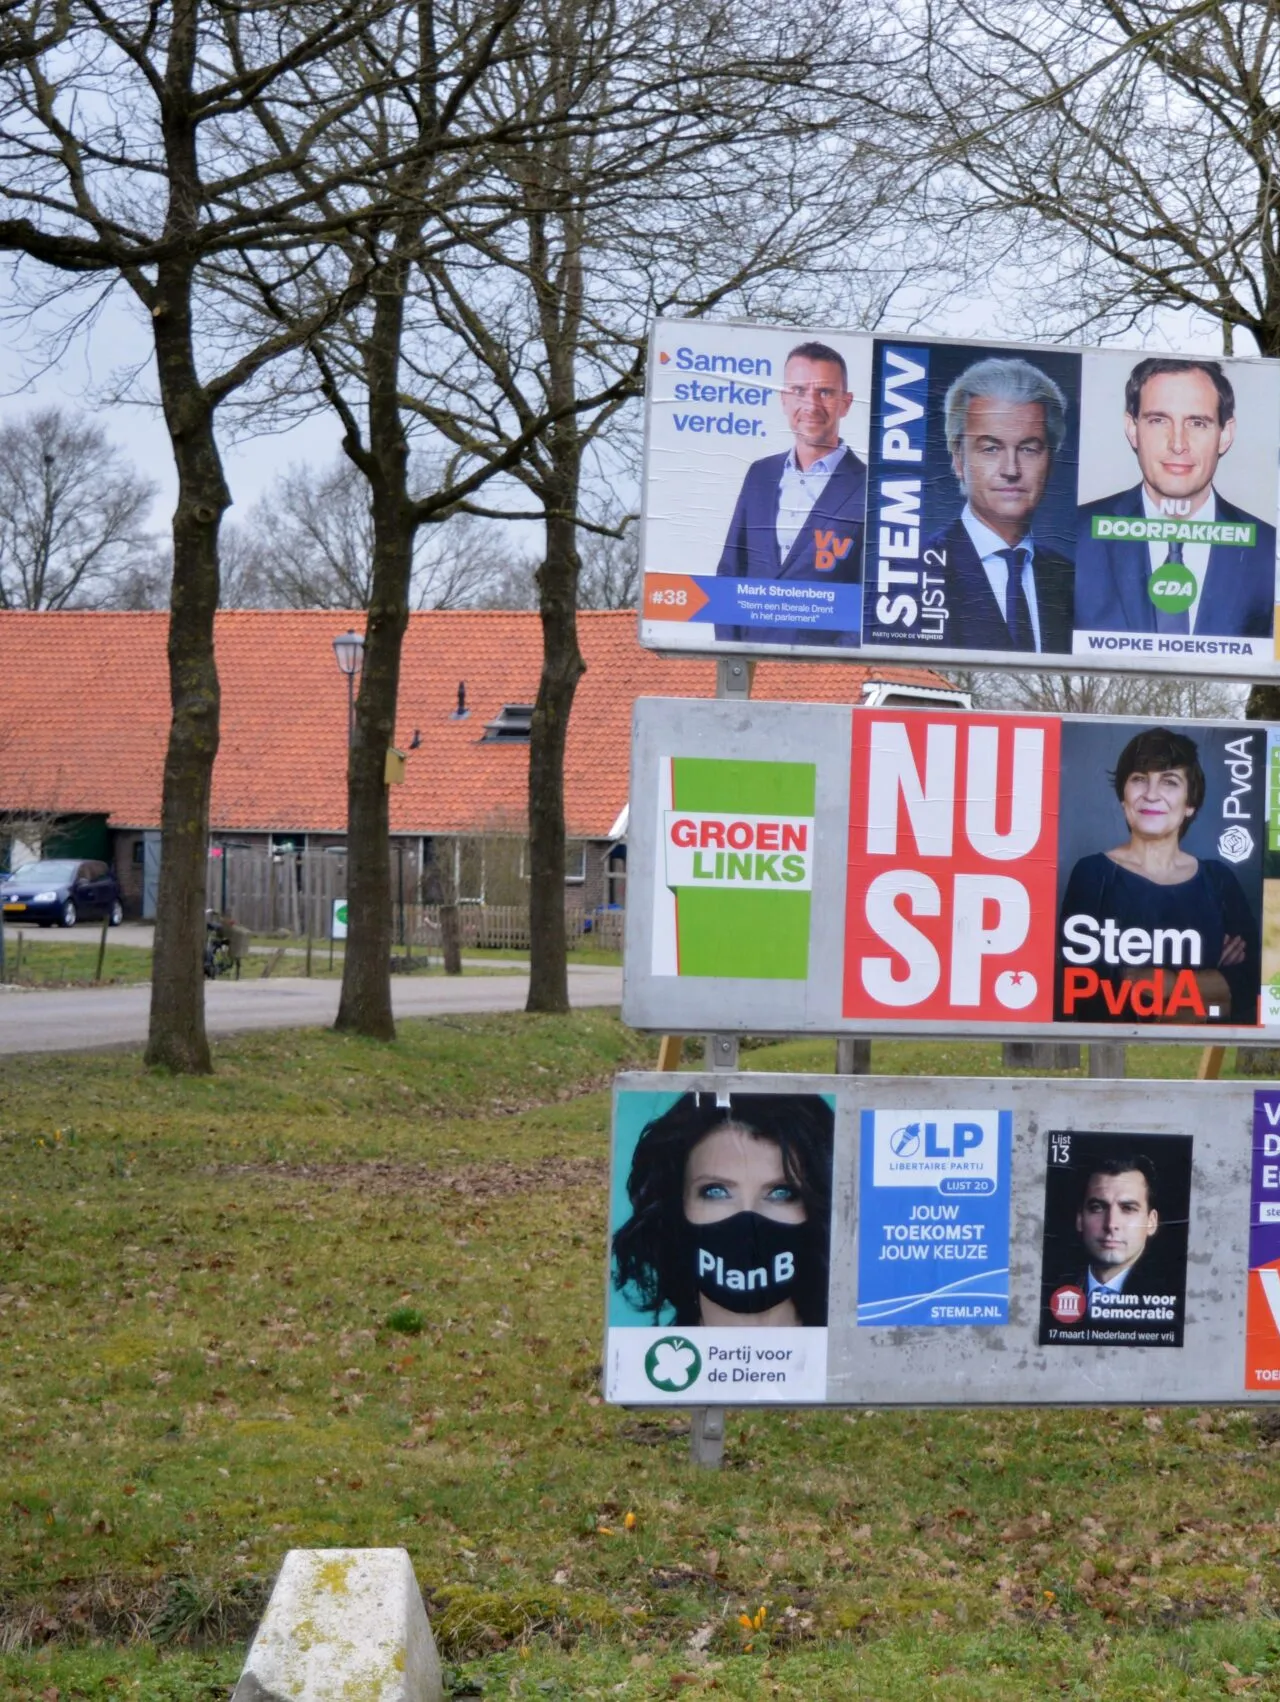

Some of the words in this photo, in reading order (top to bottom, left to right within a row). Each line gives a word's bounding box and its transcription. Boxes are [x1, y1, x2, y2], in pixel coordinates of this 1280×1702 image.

[675, 348, 772, 376] Samen
[674, 379, 773, 406] sterker
[882, 349, 928, 462] PVV
[672, 411, 767, 438] verder.
[1159, 499, 1191, 516] NU
[1096, 519, 1251, 543] DOORPAKKEN
[876, 480, 923, 627] STEM
[923, 549, 947, 567] 2
[737, 584, 767, 596] Mark
[769, 586, 836, 601] Strolenberg
[1152, 579, 1194, 597] CDA
[651, 589, 688, 606] #38
[921, 573, 951, 635] LIJST
[751, 611, 759, 620] in
[759, 612, 774, 621] het
[764, 602, 781, 611] een
[811, 604, 834, 614] Drent
[1088, 635, 1155, 653] WOPKE
[1157, 638, 1254, 656] HOEKSTRA
[1222, 735, 1254, 820] PvdA
[866, 721, 1045, 861] NU
[670, 819, 808, 852] GROEN
[692, 851, 806, 883] LINKS
[1062, 914, 1202, 966] Stem
[1063, 967, 1221, 1018] PvdA.
[925, 1122, 983, 1158] LP
[1051, 1134, 1072, 1147] Lijst
[1052, 1145, 1070, 1163] 13
[889, 1161, 948, 1171] LIBERTAIRE
[950, 1161, 985, 1171] PARTIJ
[946, 1180, 971, 1191] LIJST
[973, 1181, 989, 1191] 20
[908, 1205, 960, 1221] JOUW
[883, 1224, 985, 1241] TOEKOMST
[878, 1244, 930, 1260] JOUW
[933, 1245, 988, 1260] KEUZE
[698, 1248, 768, 1291] Plan
[774, 1251, 796, 1284] B
[1091, 1292, 1139, 1304] Forum
[1142, 1294, 1176, 1305] voor
[931, 1306, 1002, 1319] STEMLP.NL
[1091, 1306, 1175, 1320] Democratie
[1049, 1329, 1058, 1338] 17
[1060, 1330, 1085, 1339] maart
[1091, 1330, 1136, 1340] Nederland
[1138, 1332, 1160, 1340] weer
[1161, 1331, 1175, 1341] vrij
[708, 1346, 752, 1364] Partij
[755, 1349, 793, 1361] voor
[707, 1368, 728, 1382] de
[732, 1369, 787, 1383] Dieren
